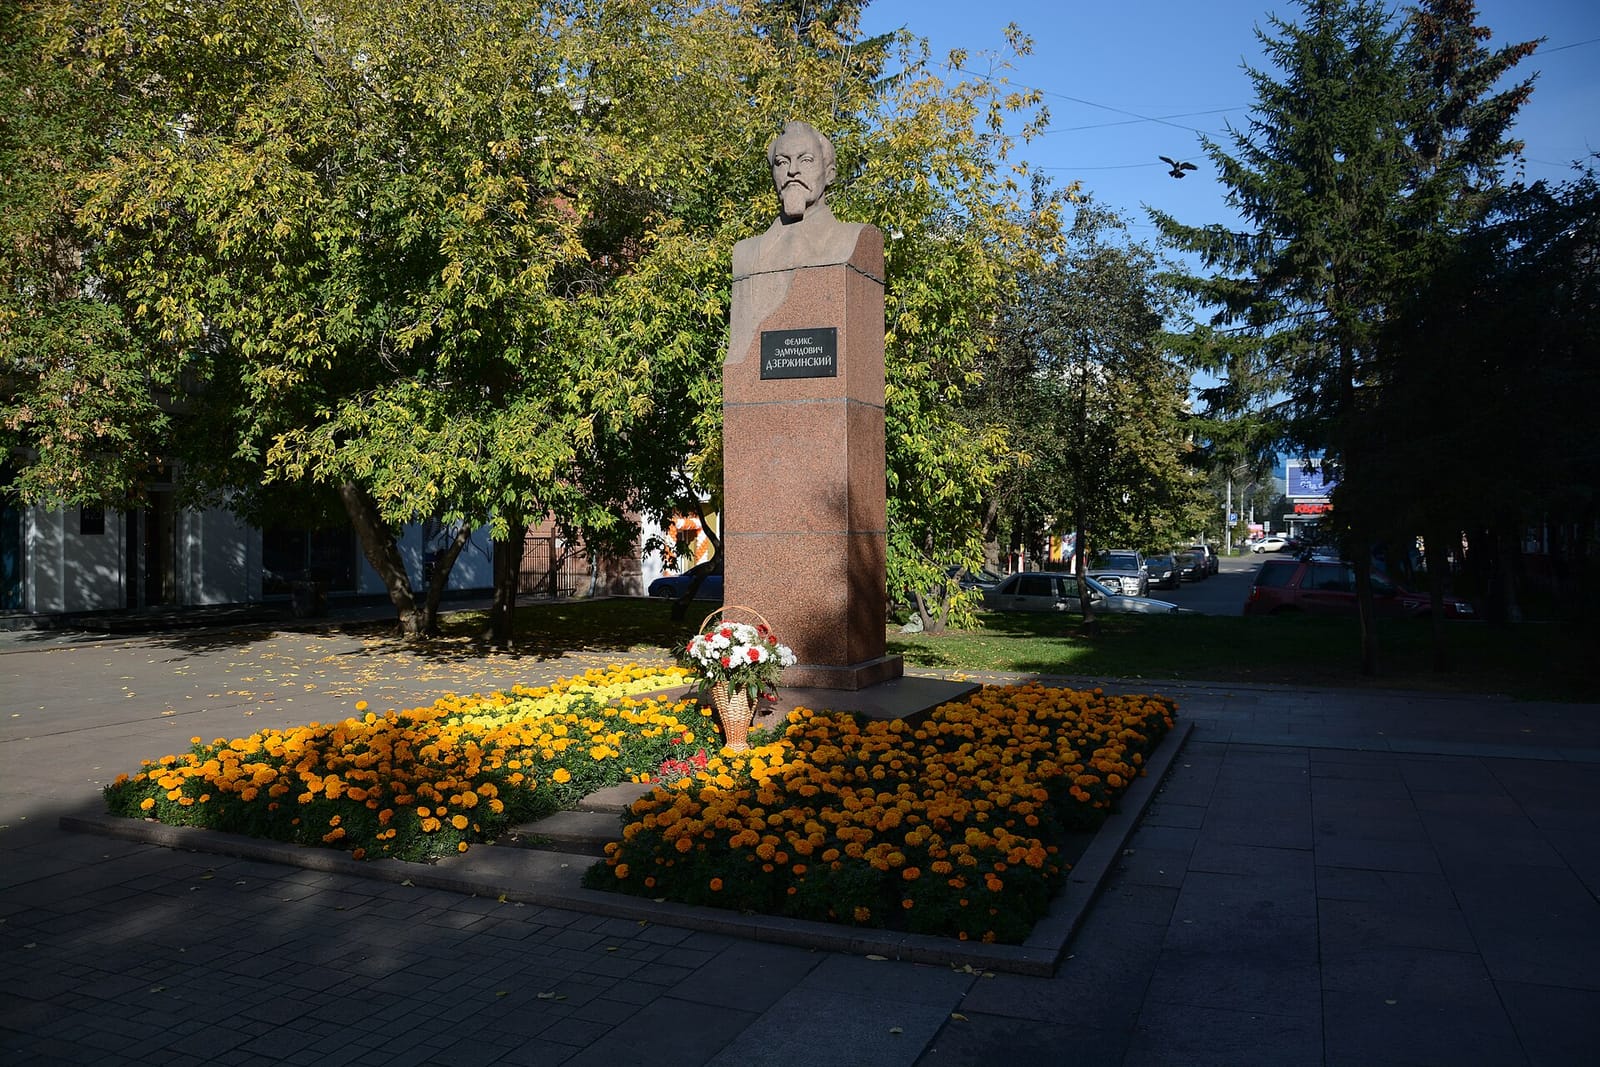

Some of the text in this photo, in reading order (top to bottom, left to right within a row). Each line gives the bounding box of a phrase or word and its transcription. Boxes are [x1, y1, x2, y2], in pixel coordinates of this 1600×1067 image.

[784, 336, 813, 345] ФЕЛИКС
[774, 346, 823, 357] ЭДМУНДОВИЧ
[765, 355, 832, 370] ДЗЕРЖИНСКИЙ
